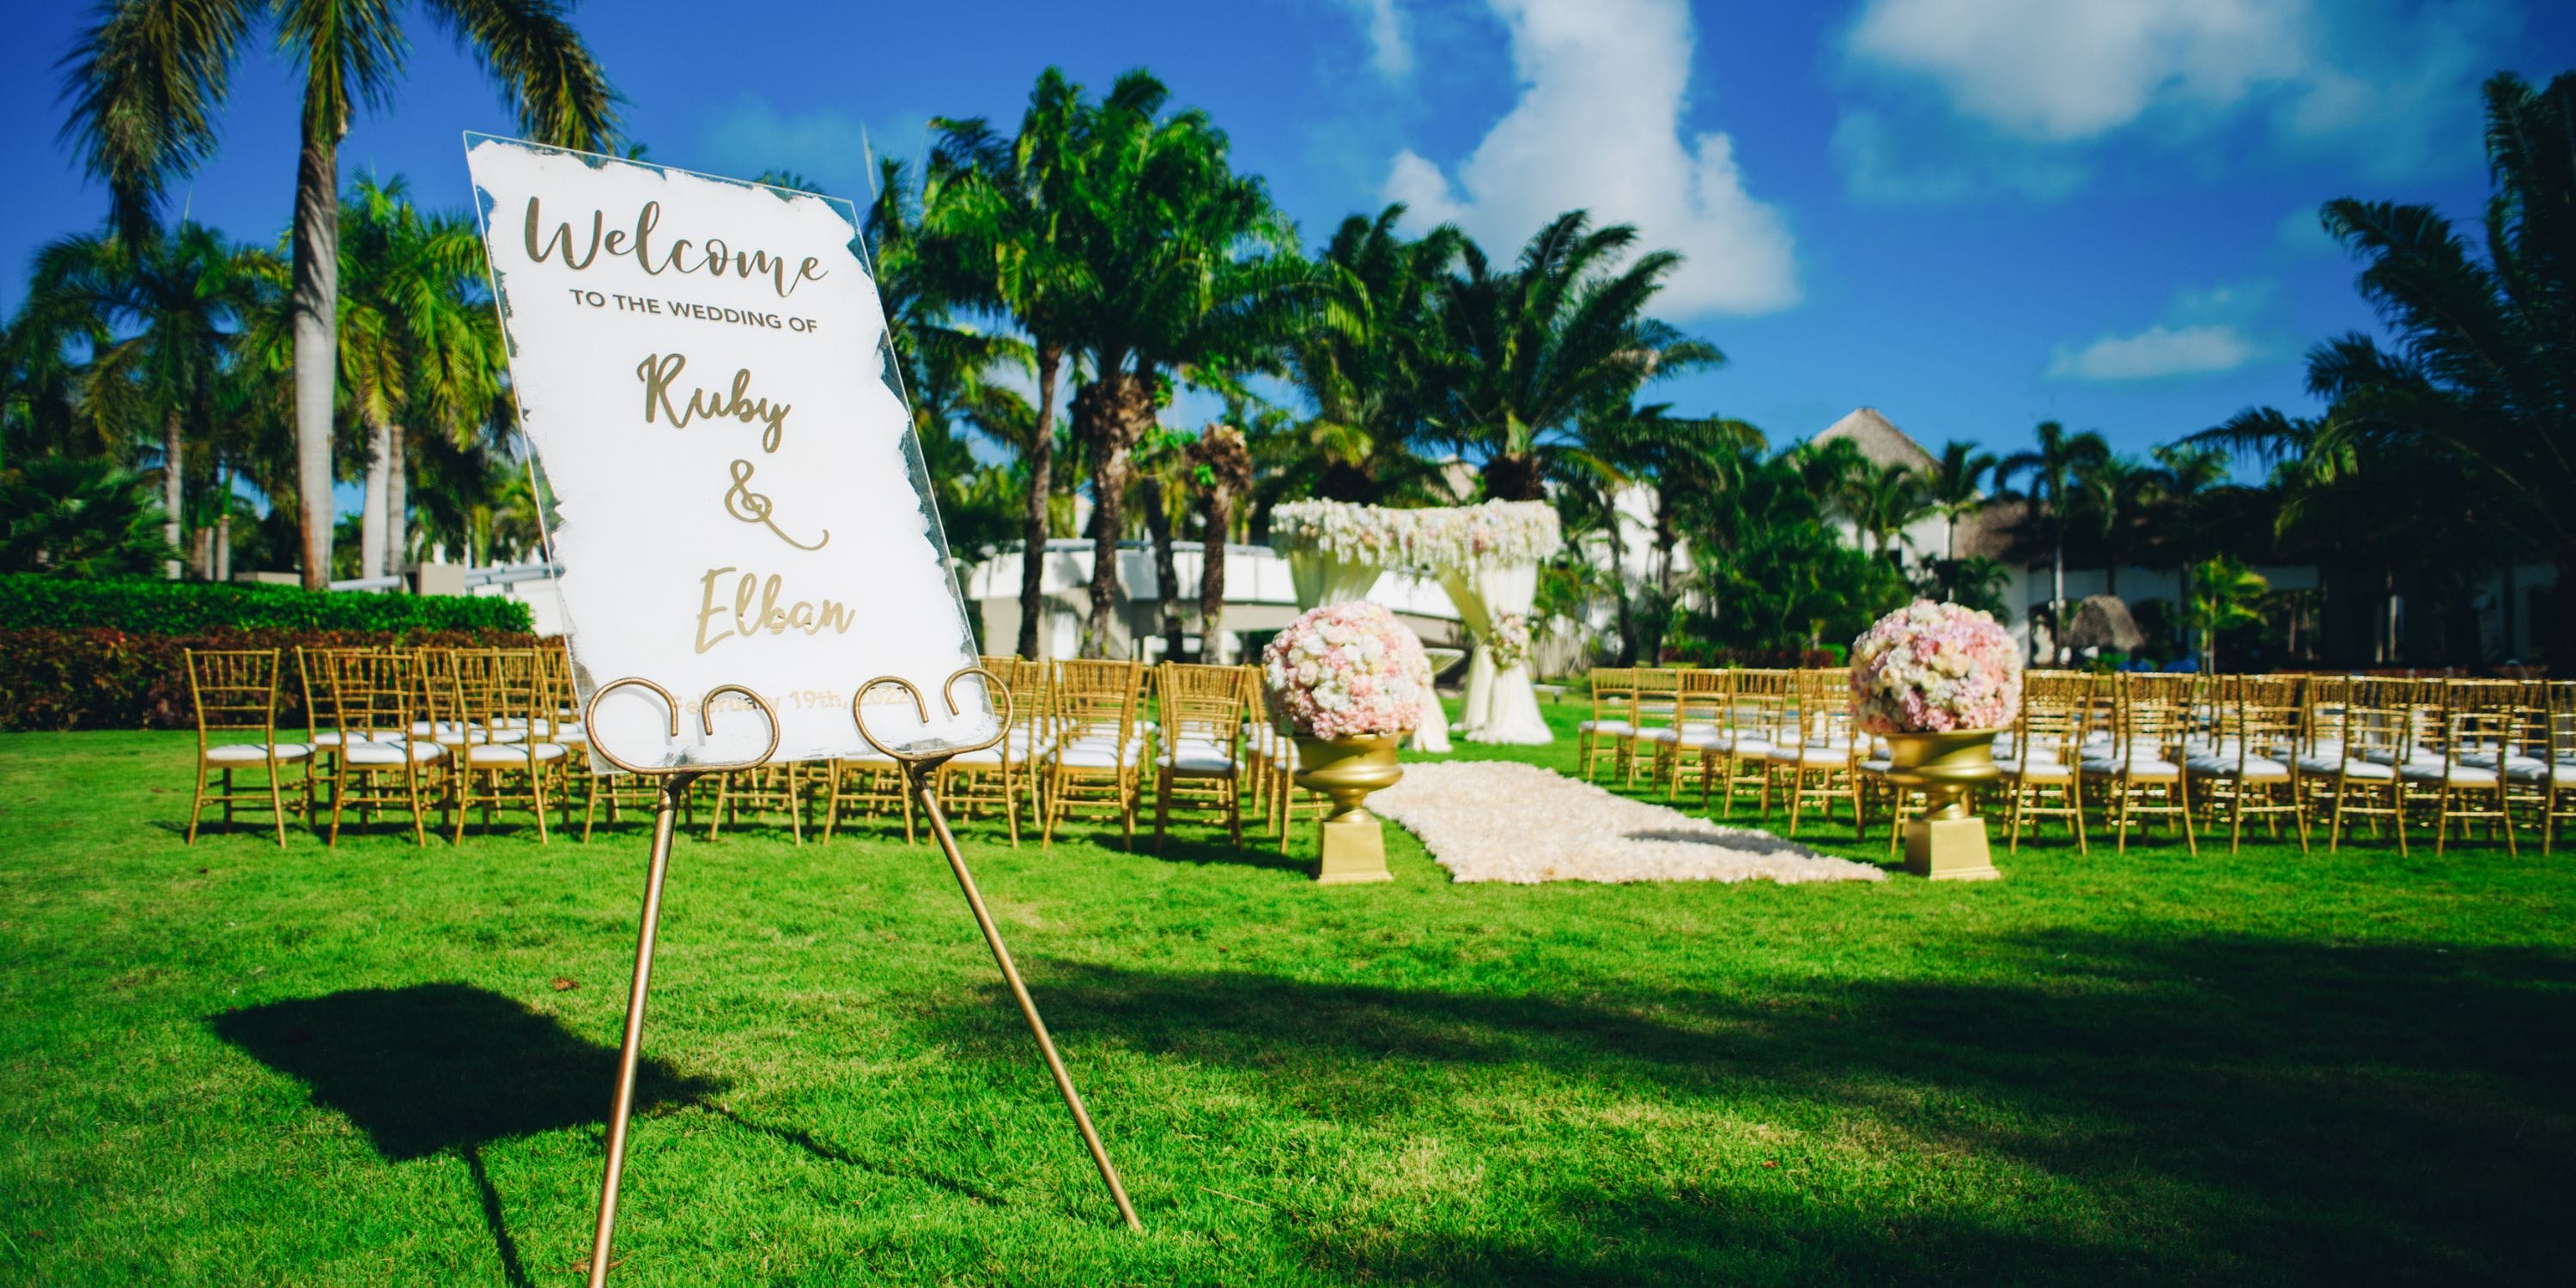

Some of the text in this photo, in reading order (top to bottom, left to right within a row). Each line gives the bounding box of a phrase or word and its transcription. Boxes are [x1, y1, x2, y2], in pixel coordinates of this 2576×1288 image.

[525, 197, 829, 297] Welcome
[569, 289, 817, 333] TO THE WEDDING OF
[637, 353, 791, 453] Ruby
[725, 459, 829, 551] &
[670, 692, 781, 714] Februay
[789, 689, 848, 709] 19th,
